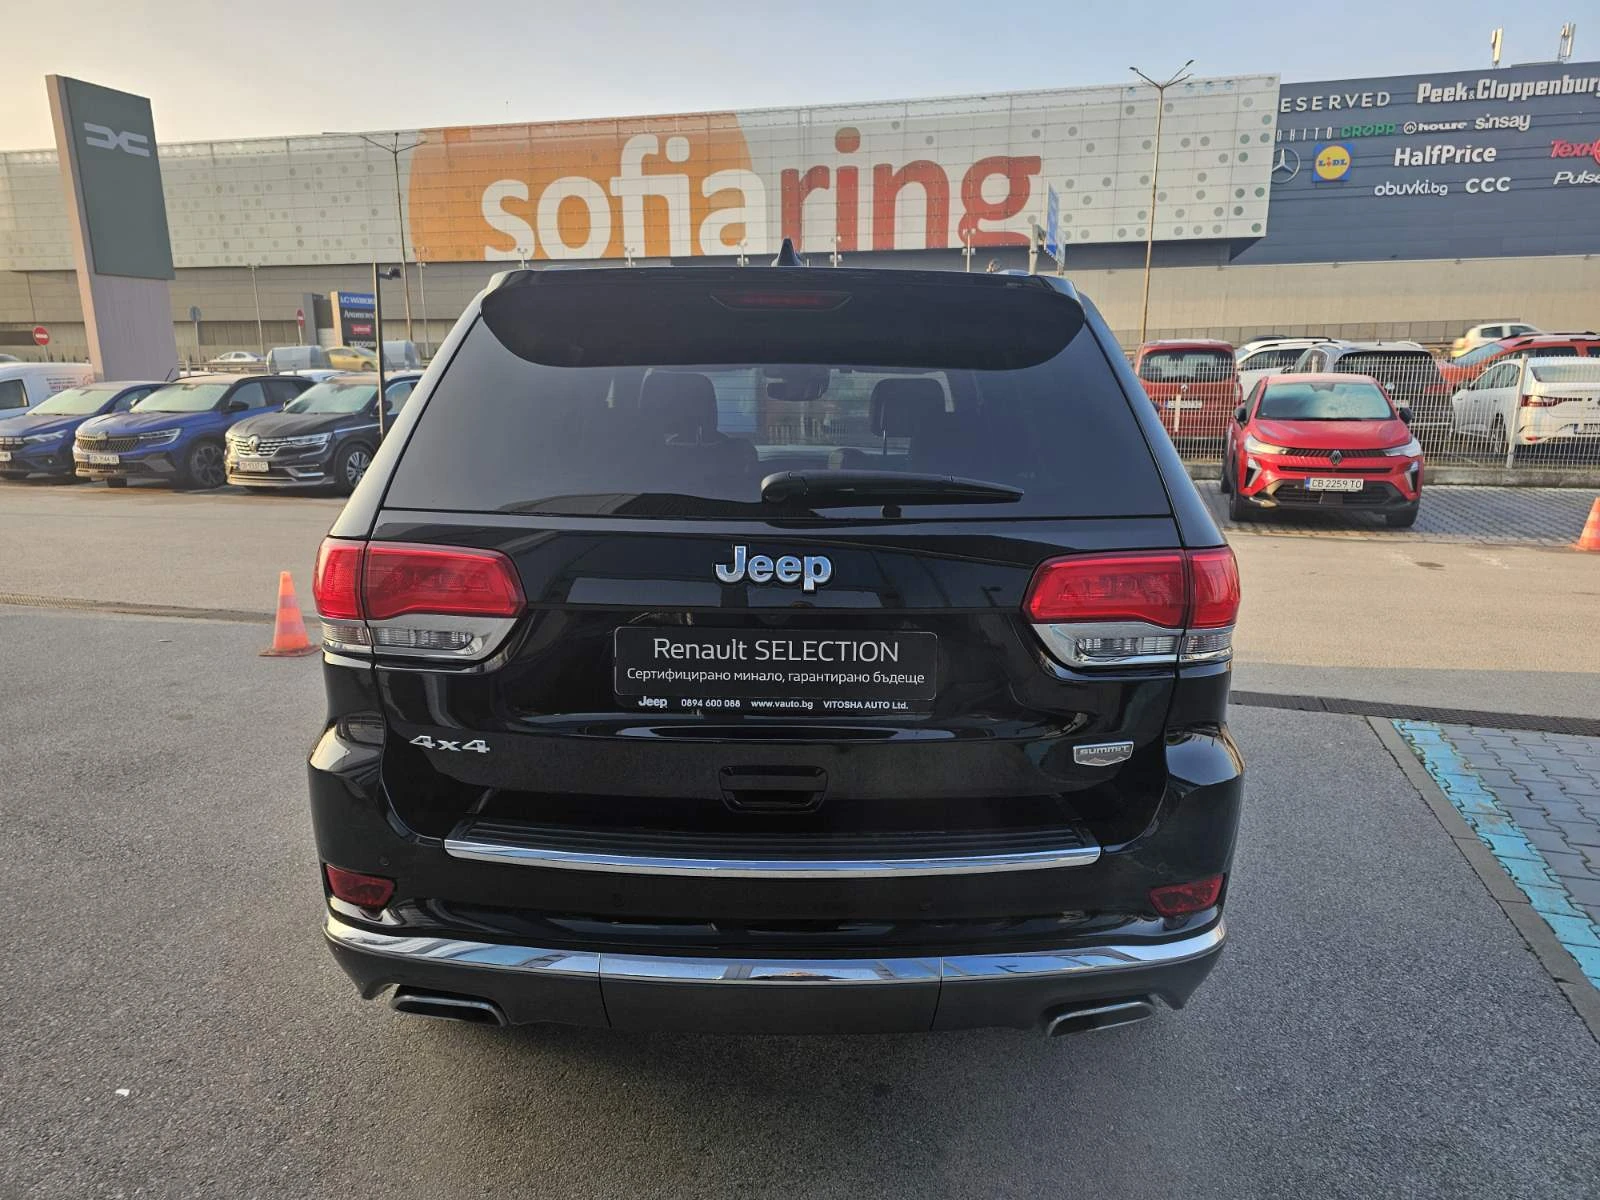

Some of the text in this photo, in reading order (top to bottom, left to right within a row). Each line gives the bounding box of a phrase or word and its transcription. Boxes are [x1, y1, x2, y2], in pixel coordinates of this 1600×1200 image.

[1280, 91, 1391, 113] ESERVED
[1341, 122, 1397, 138] CROPP
[1474, 113, 1531, 132] sinsay
[1276, 126, 1333, 142] OHITO
[1393, 144, 1497, 167] HalfPrice
[1374, 179, 1448, 197] obuvki.bg
[1465, 176, 1511, 194] CCC
[1326, 479, 1348, 489] 2259
[714, 545, 832, 592] Jeep
[653, 637, 899, 663] Renault SELECTION
[627, 667, 925, 685] Сертифицирано минало, гарантирано бъдеще
[638, 696, 909, 710] Jeep 0894 600 088 www.vauto.bg VITOSHA AUTO Ltd.
[409, 735, 490, 753] 4x4
